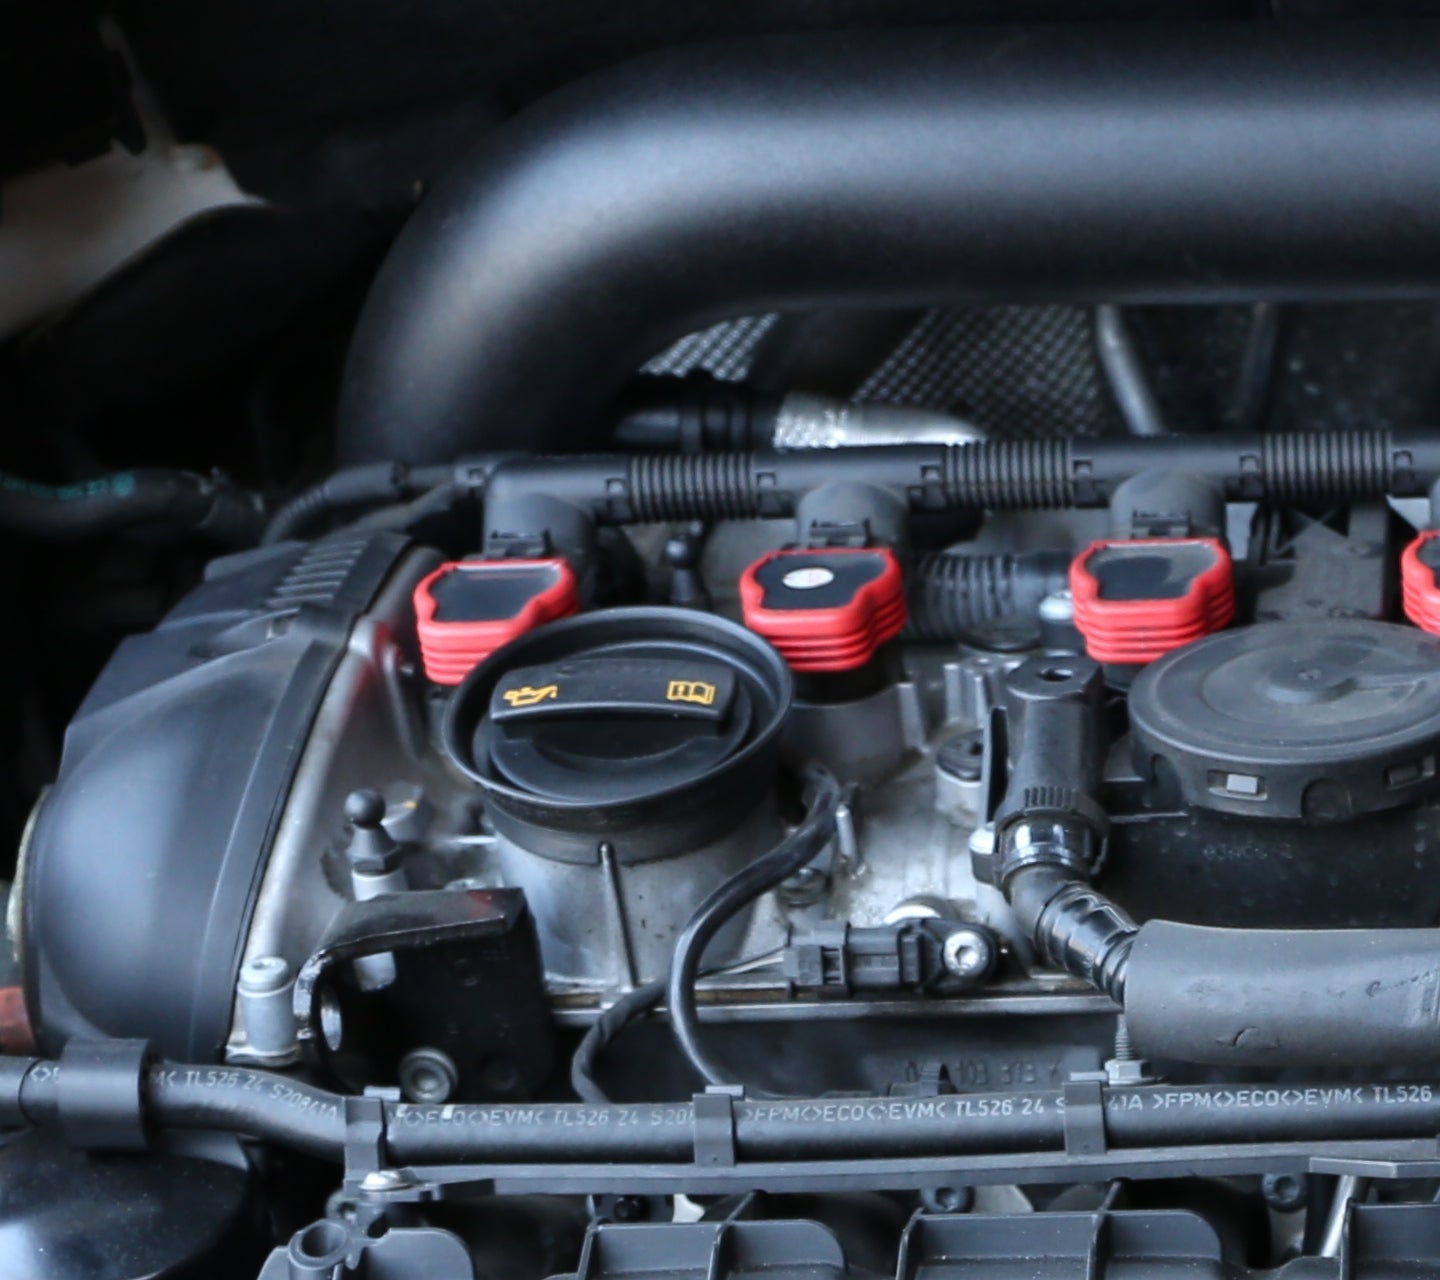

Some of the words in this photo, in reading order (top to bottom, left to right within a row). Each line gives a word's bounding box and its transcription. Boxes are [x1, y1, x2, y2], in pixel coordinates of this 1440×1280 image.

[1373, 1085, 1432, 1104] TL526
[954, 1099, 1013, 1117] TL526
[1021, 1098, 1045, 1115] 24
[553, 1110, 609, 1126] TL526
[617, 1110, 639, 1126] 24
